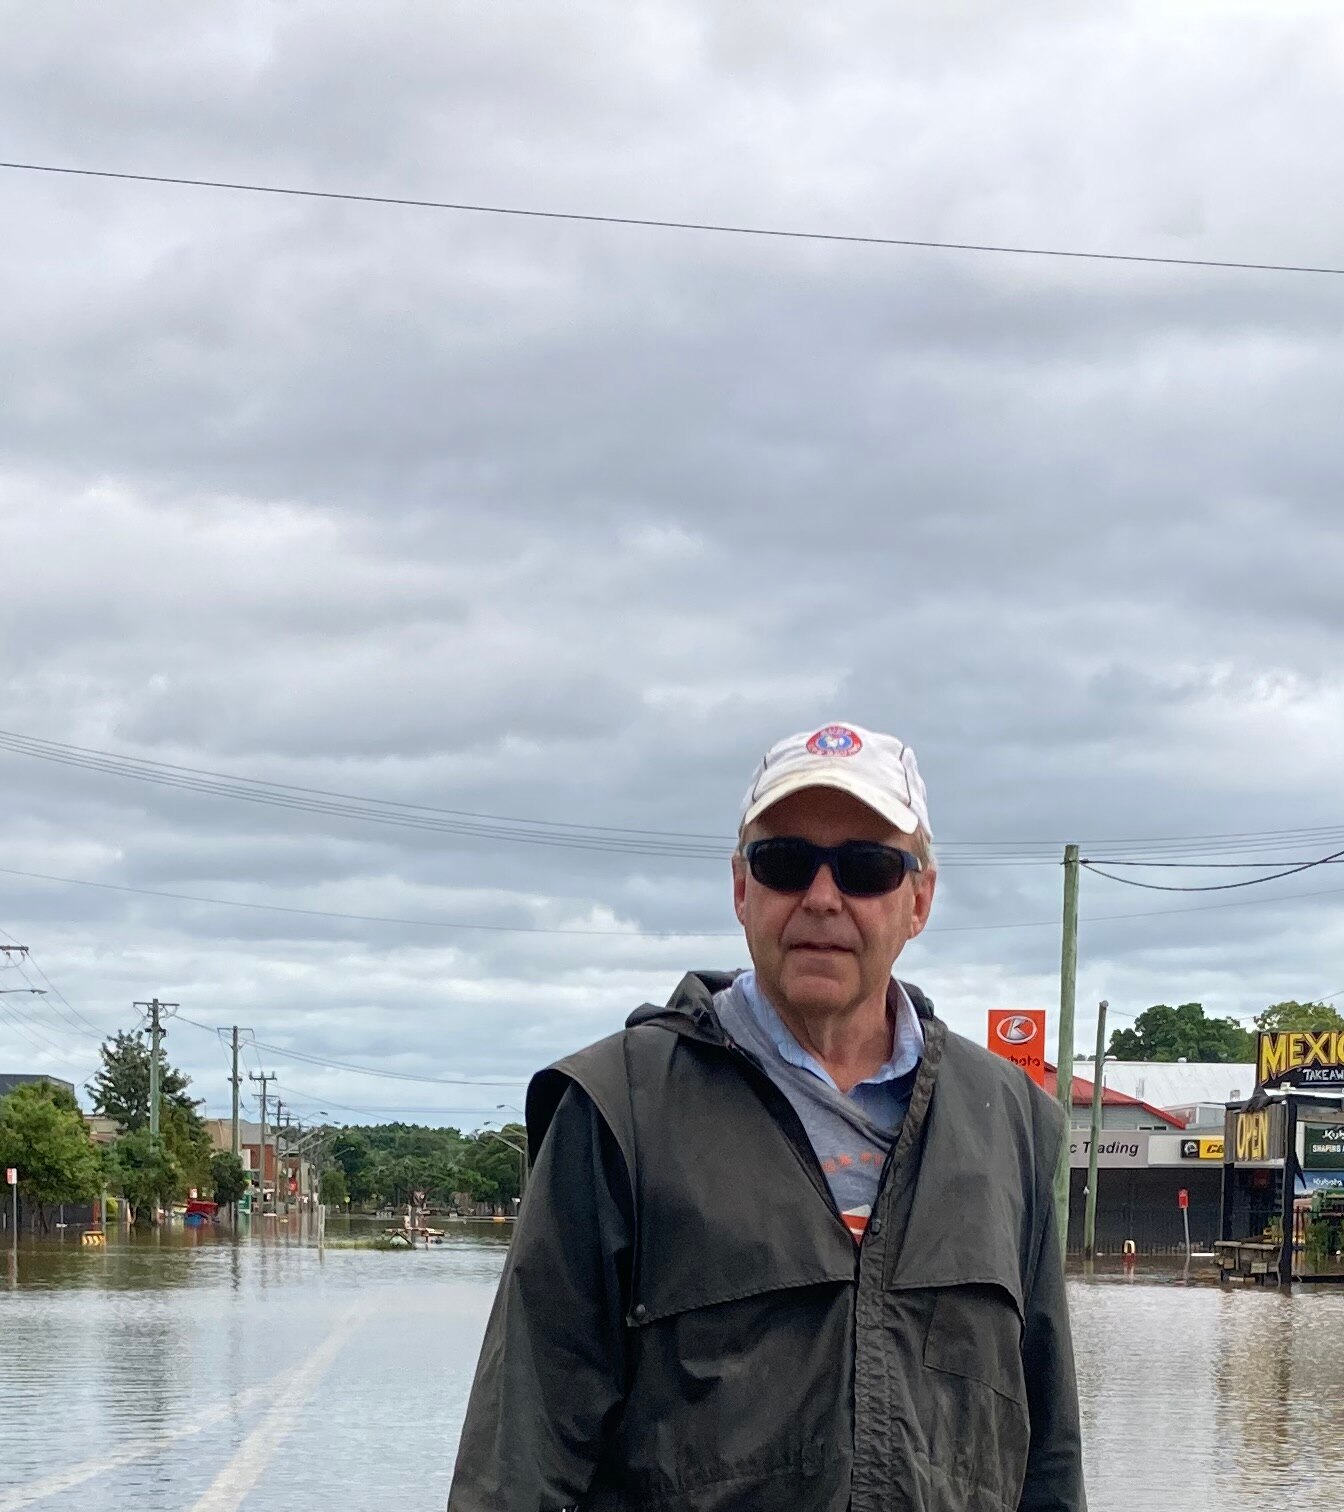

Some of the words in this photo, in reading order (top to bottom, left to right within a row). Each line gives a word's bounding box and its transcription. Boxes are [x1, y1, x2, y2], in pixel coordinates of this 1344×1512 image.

[1008, 1055, 1041, 1067] bota
[1237, 1111, 1268, 1161] OPEN
[1083, 1141, 1139, 1157] Tading
[1313, 1178, 1343, 1187] Kubota
